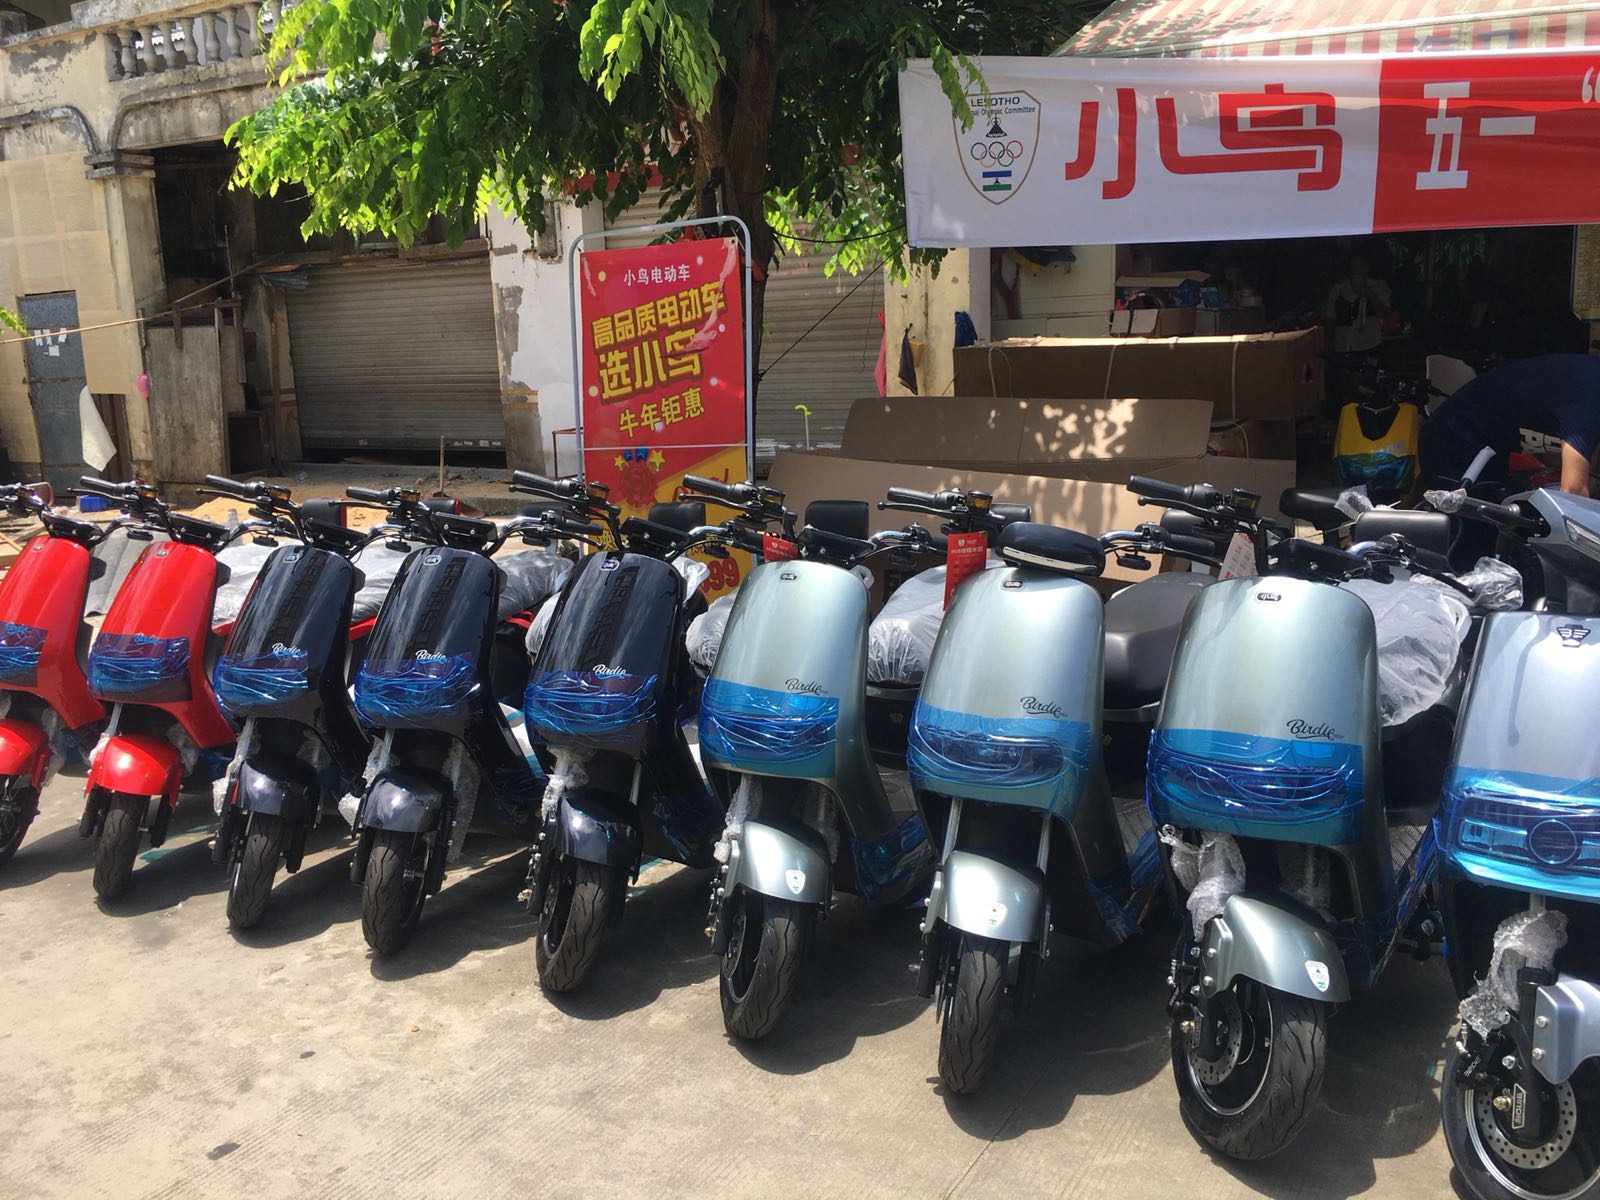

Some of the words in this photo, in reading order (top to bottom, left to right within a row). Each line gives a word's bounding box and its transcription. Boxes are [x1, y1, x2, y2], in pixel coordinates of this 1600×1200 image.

[970, 96, 1021, 107] LEOTHO
[1065, 82, 1343, 200] 小鸟
[623, 264, 691, 287] 小鸟电动车
[591, 280, 727, 350] 高品质电动车
[599, 327, 703, 400] 选小鸟
[619, 387, 705, 438] 牛年钜惠
[592, 663, 627, 679] Birdie
[785, 678, 823, 696] Birdie
[1020, 696, 1062, 718] Birdie
[1286, 719, 1336, 741] Birdie
